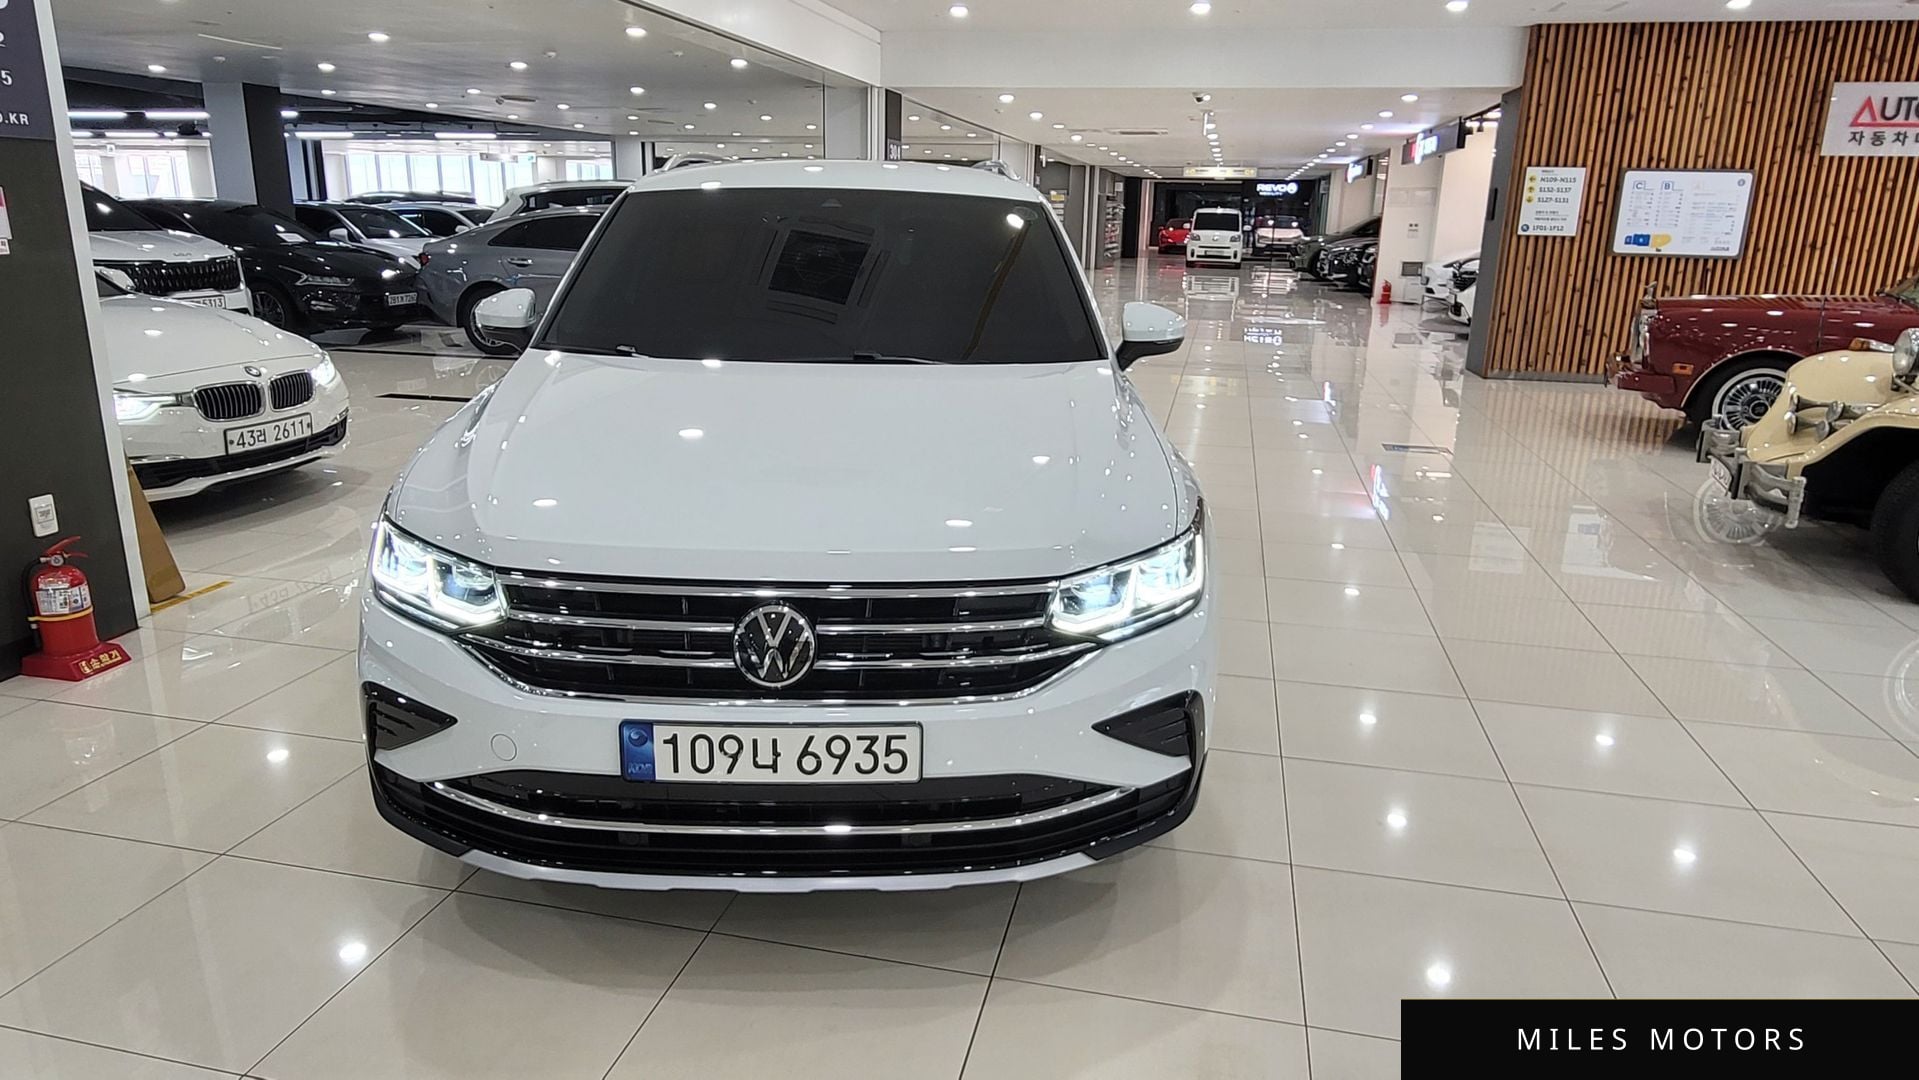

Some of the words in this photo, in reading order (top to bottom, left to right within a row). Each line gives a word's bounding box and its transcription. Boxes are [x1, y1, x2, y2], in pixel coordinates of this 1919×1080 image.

[1849, 95, 1919, 127] AUT
[273, 419, 304, 442] 2611
[662, 733, 781, 775] 109나
[796, 735, 909, 775] 6935
